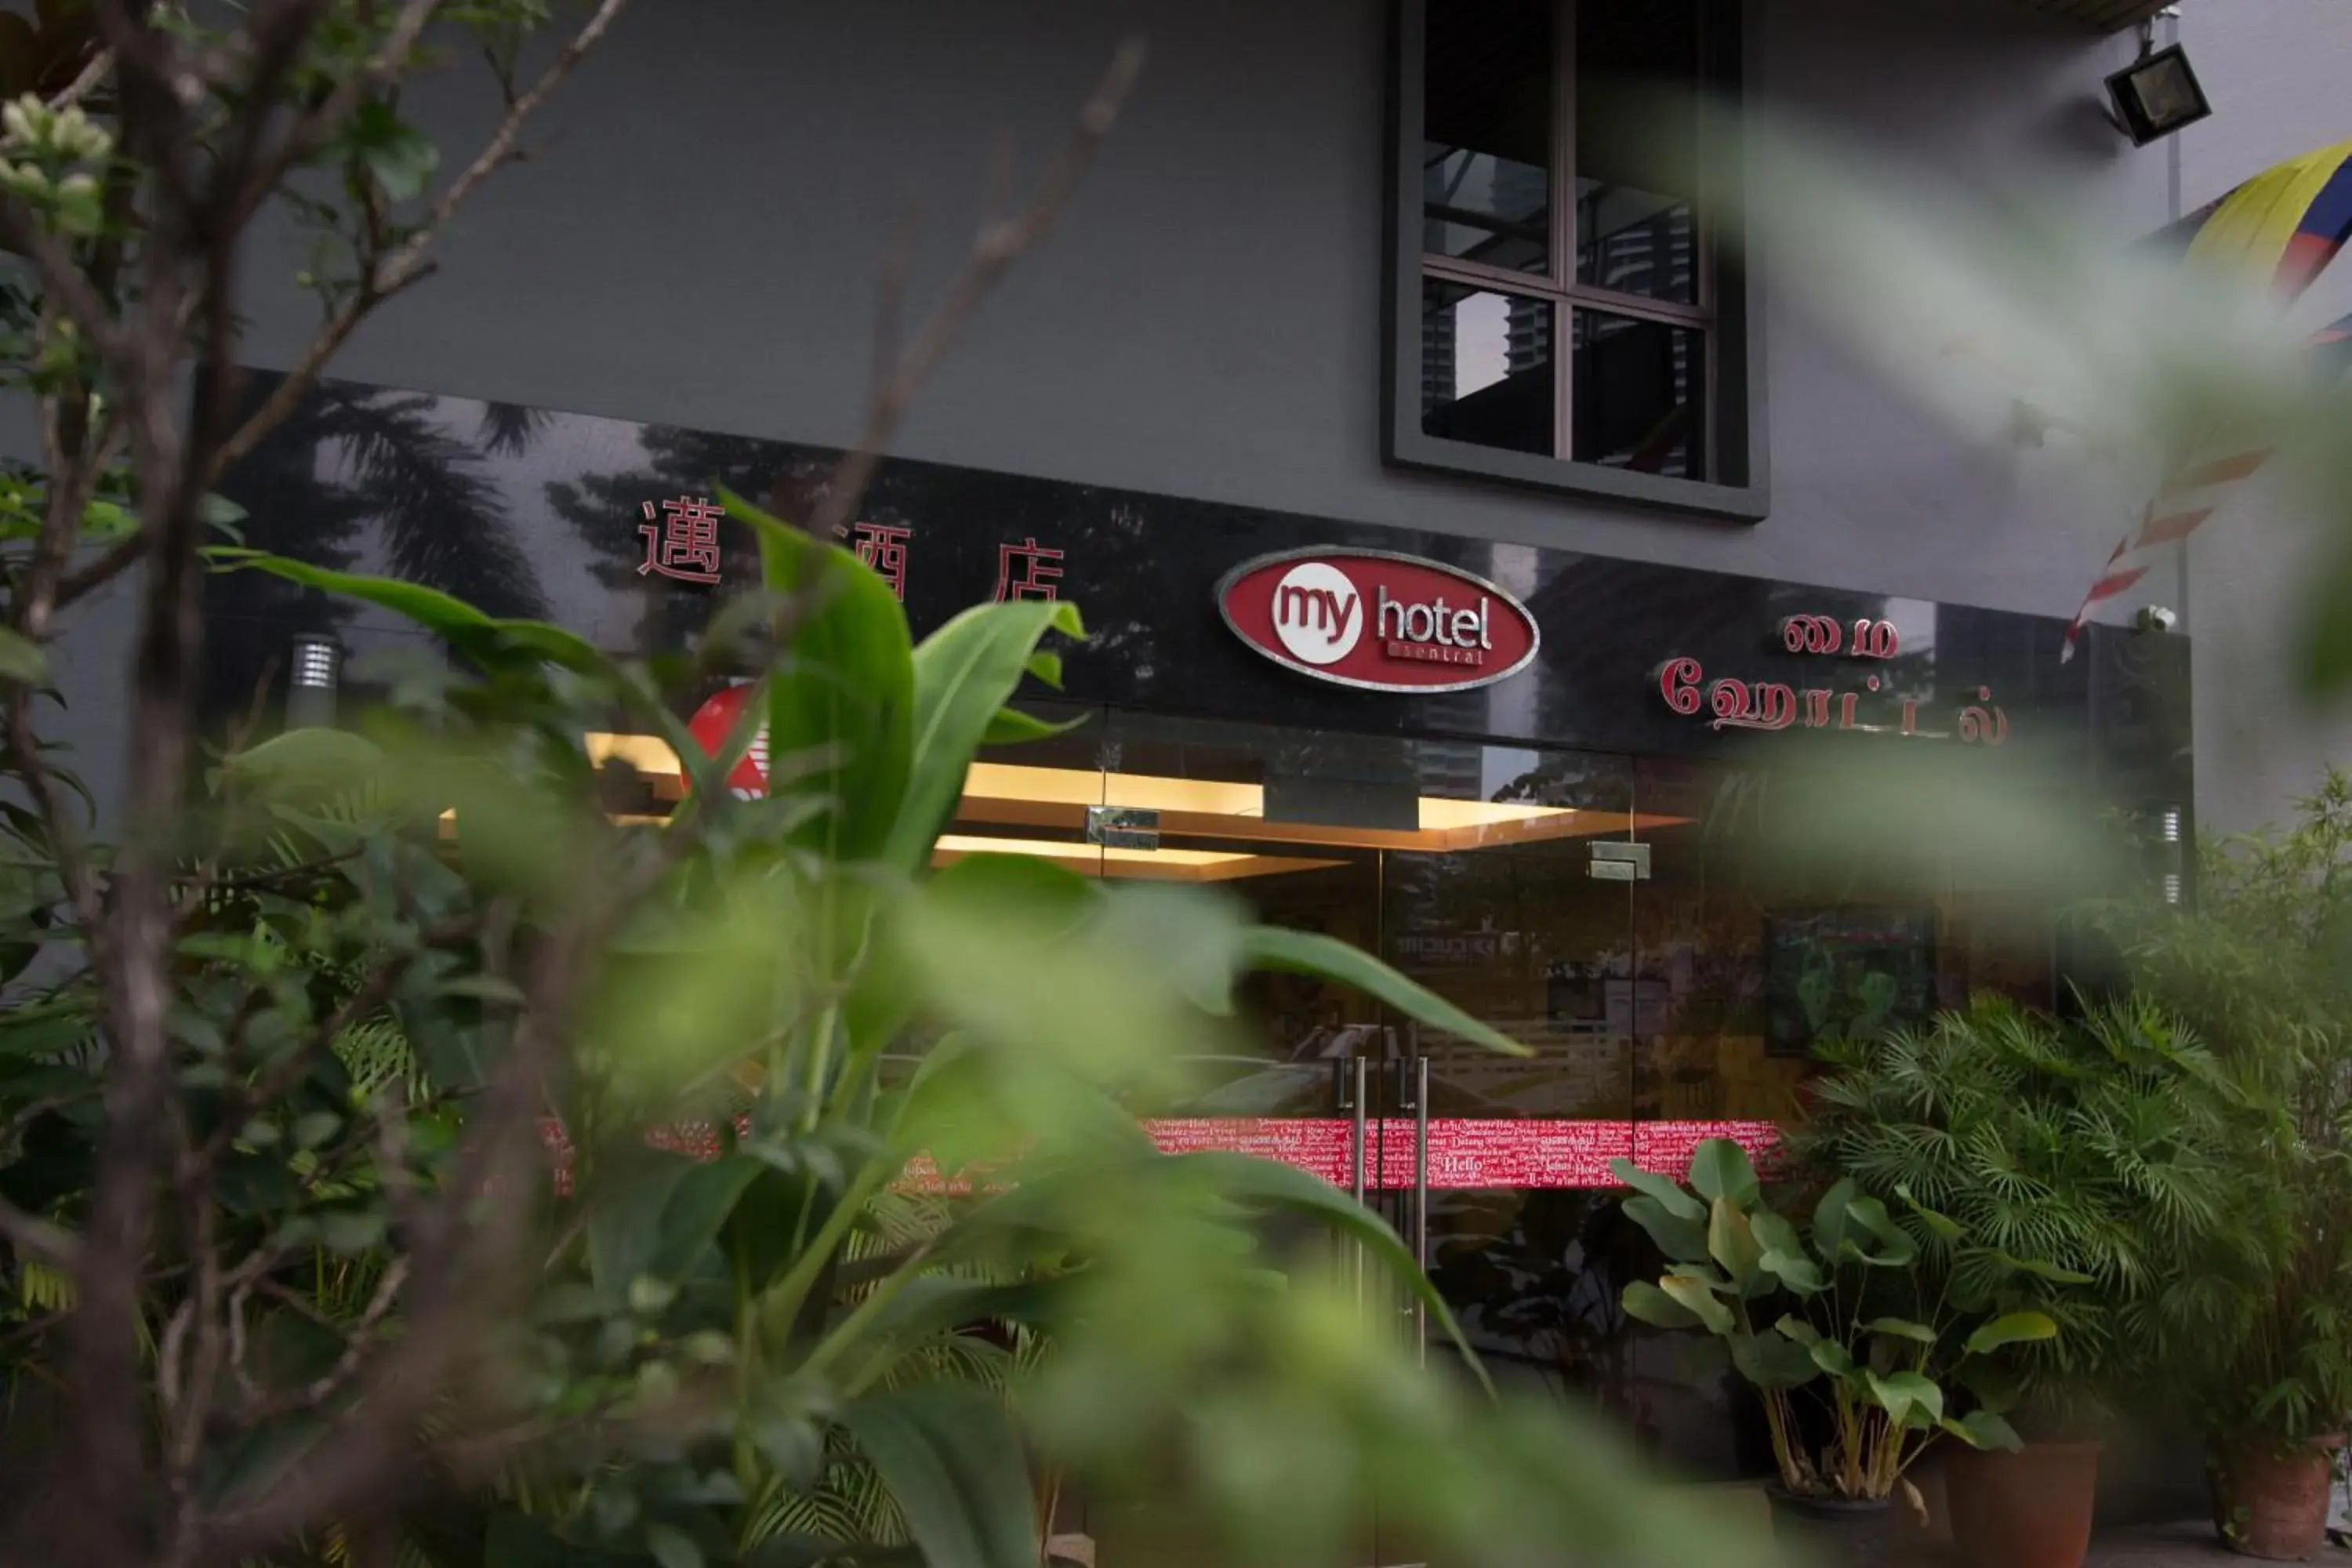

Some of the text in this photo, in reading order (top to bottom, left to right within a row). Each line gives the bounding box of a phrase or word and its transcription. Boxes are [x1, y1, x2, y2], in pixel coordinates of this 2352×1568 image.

[1279, 584, 1492, 650] my hotel
[1444, 1156, 1483, 1172] Hello
